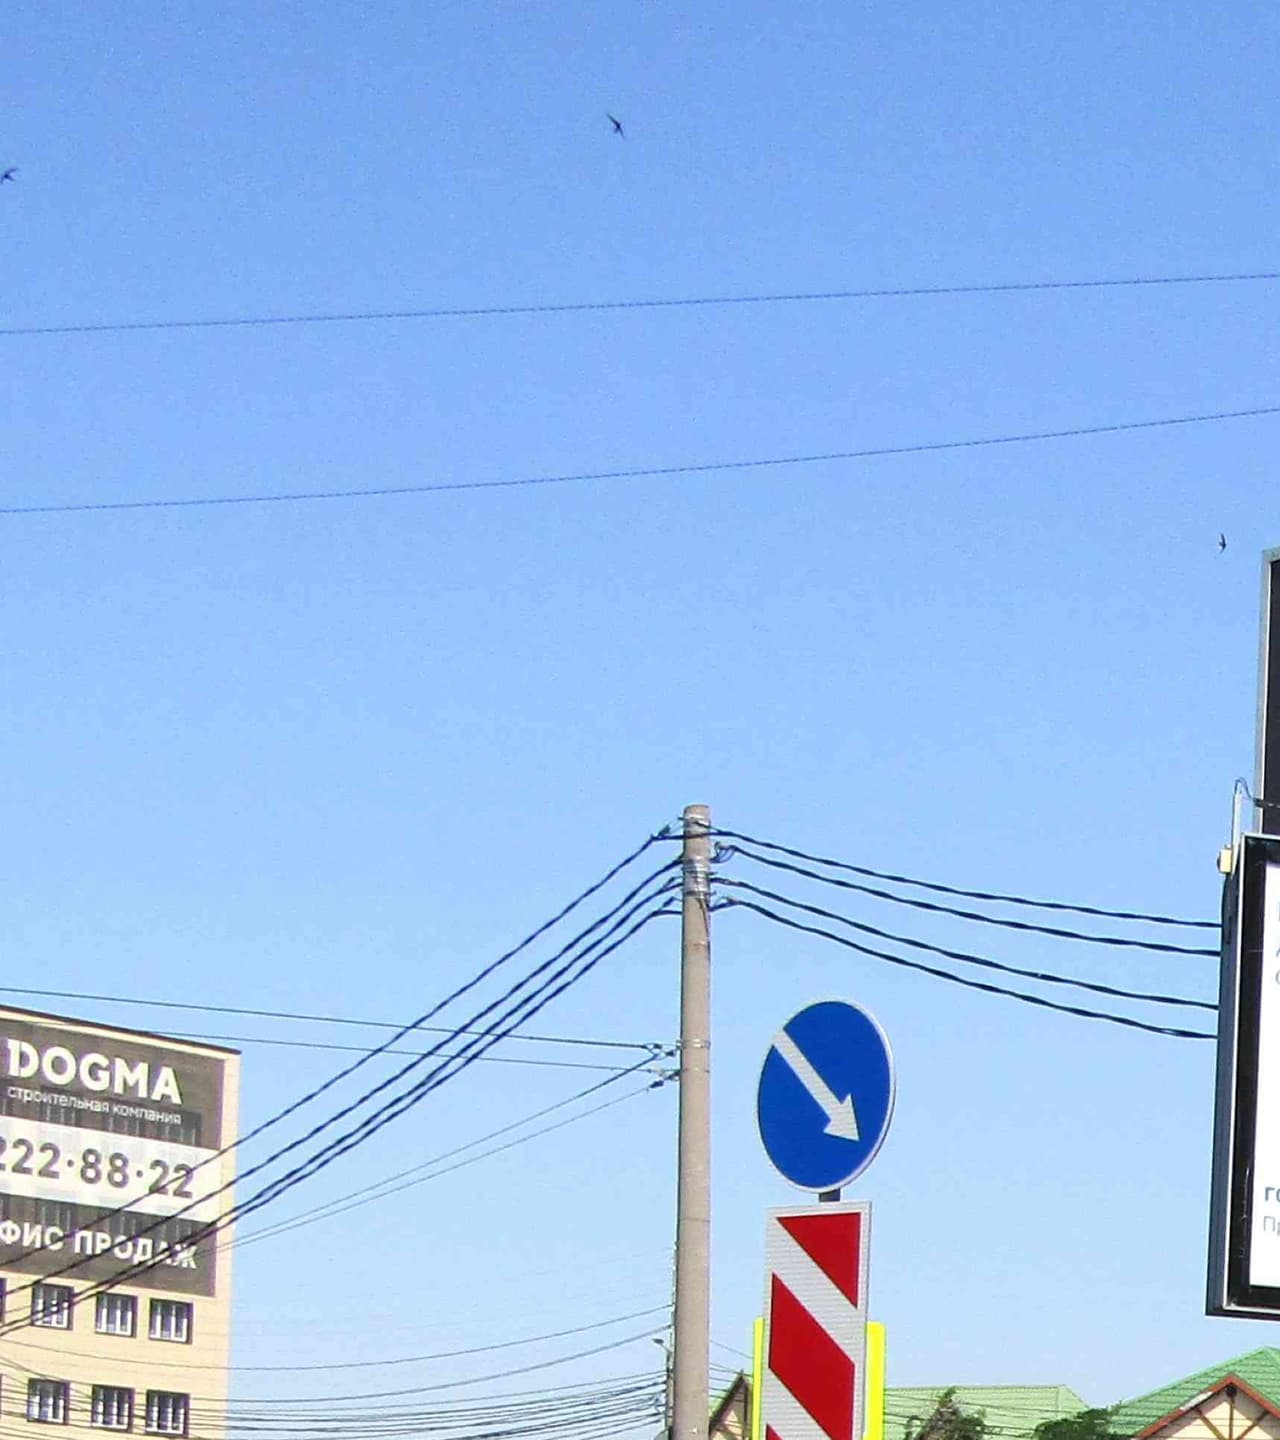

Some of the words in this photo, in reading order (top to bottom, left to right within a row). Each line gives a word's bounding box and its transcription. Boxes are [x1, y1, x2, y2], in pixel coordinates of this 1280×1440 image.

[7, 1038, 183, 1105] DOGMA
[7, 1086, 110, 1113] строительная
[113, 1099, 182, 1124] компания
[0, 1219, 65, 1251] ФИС
[74, 1229, 197, 1269] ПРОДАЖ
